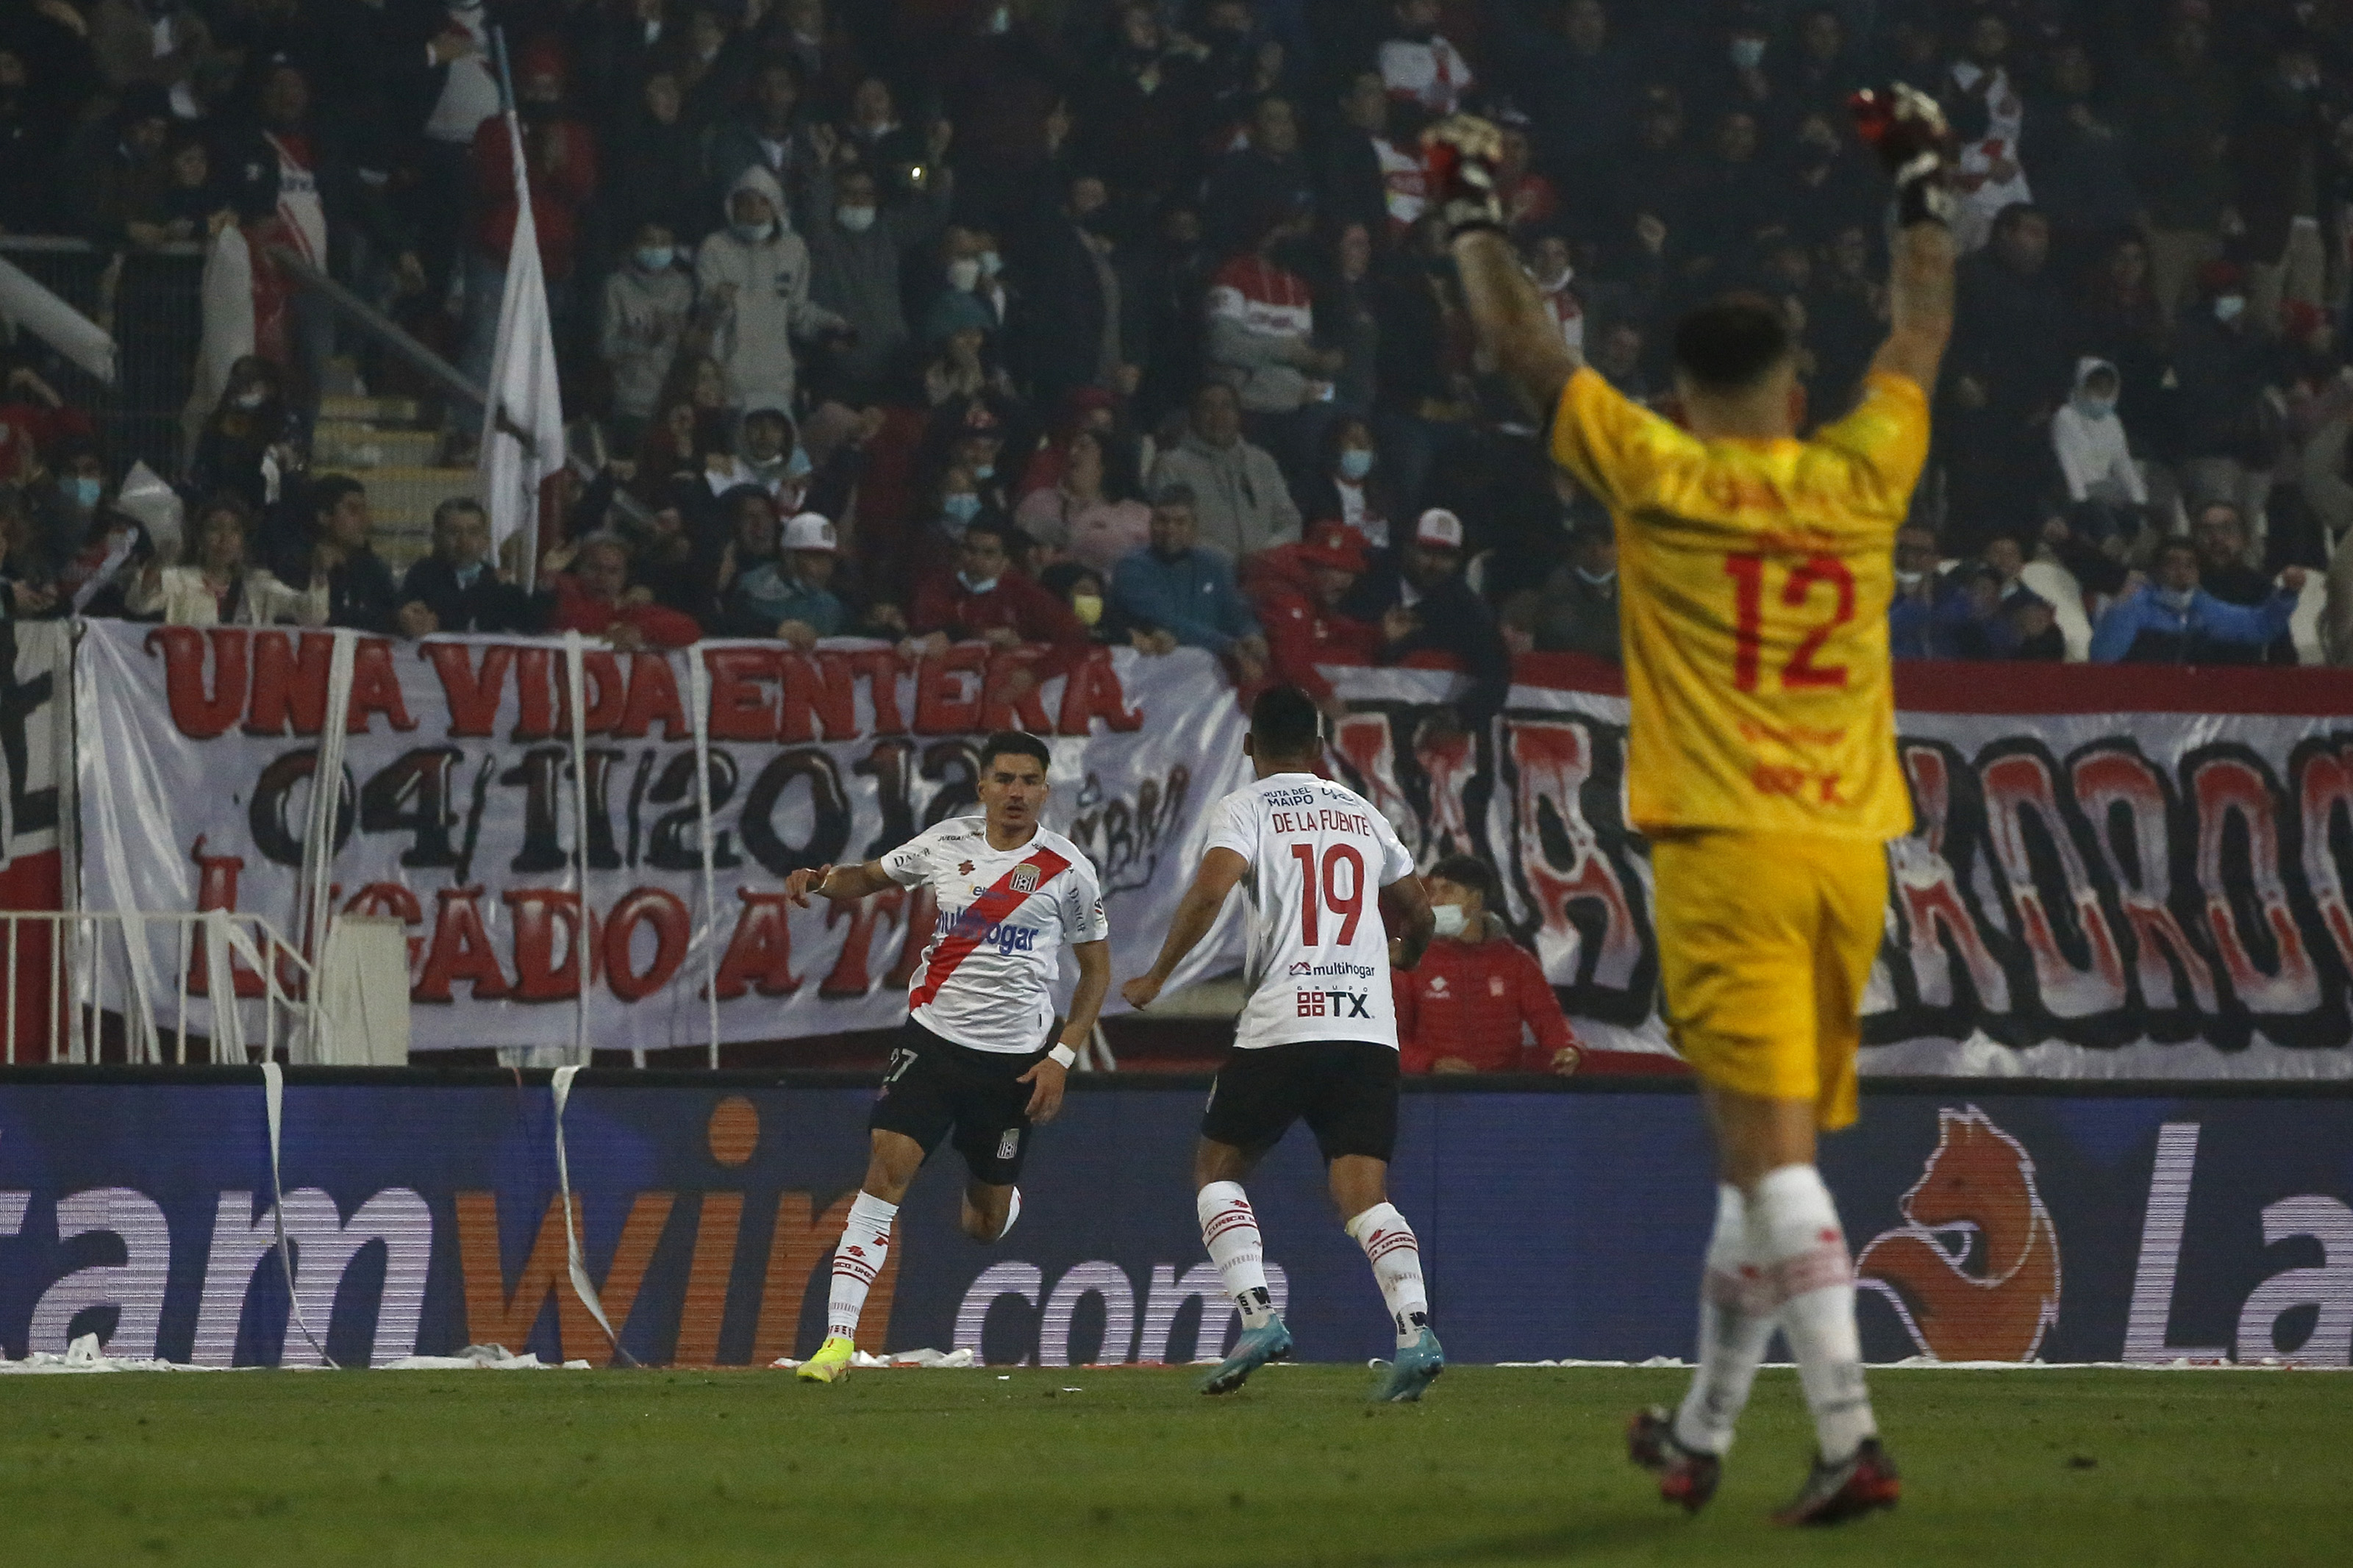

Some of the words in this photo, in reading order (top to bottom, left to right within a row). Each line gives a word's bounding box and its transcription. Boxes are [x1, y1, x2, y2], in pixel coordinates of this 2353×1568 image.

[1726, 551, 1855, 693] 12
[145, 626, 420, 740] UNA
[418, 640, 693, 741] VIDA
[1263, 790, 1289, 798] RUTA
[1292, 787, 1312, 795] DEL
[1268, 794, 1314, 806] MAIPO
[1272, 812, 1295, 834] DE
[1296, 811, 1318, 831] LA
[1319, 809, 1371, 837] FUENTE
[1291, 843, 1365, 947] 19
[701, 889, 803, 1000] A
[1313, 962, 1375, 978] multihogar
[1326, 992, 1371, 1019] TX
[882, 1047, 919, 1083] 27
